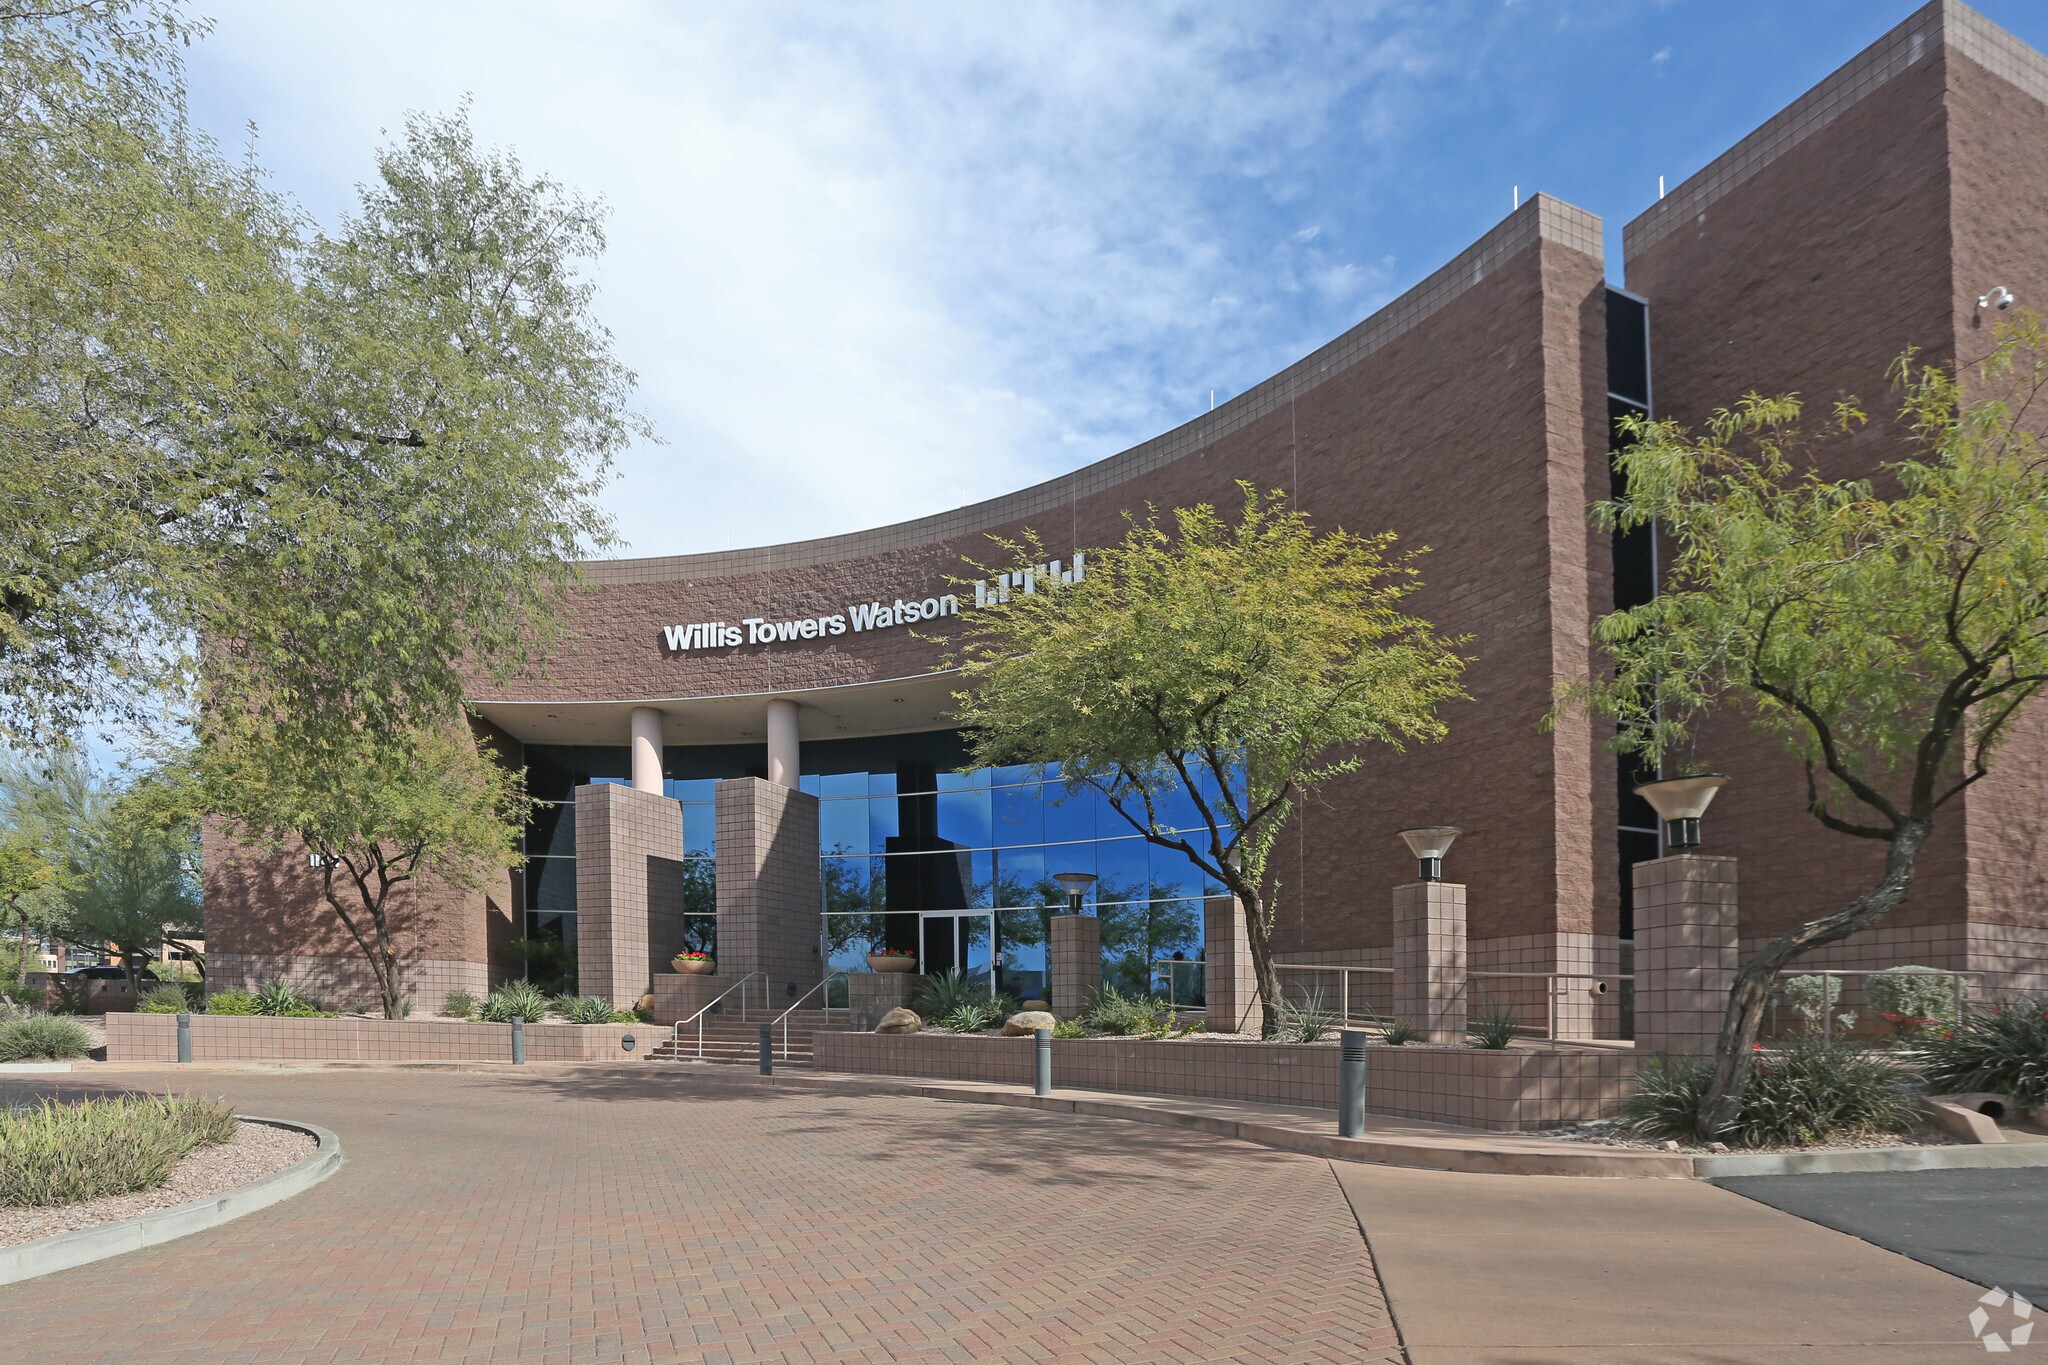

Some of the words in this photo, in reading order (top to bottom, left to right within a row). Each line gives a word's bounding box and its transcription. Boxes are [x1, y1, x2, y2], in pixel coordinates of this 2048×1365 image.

[664, 623, 742, 650] Willis
[743, 616, 846, 644] Towers
[849, 593, 959, 632] Watson
